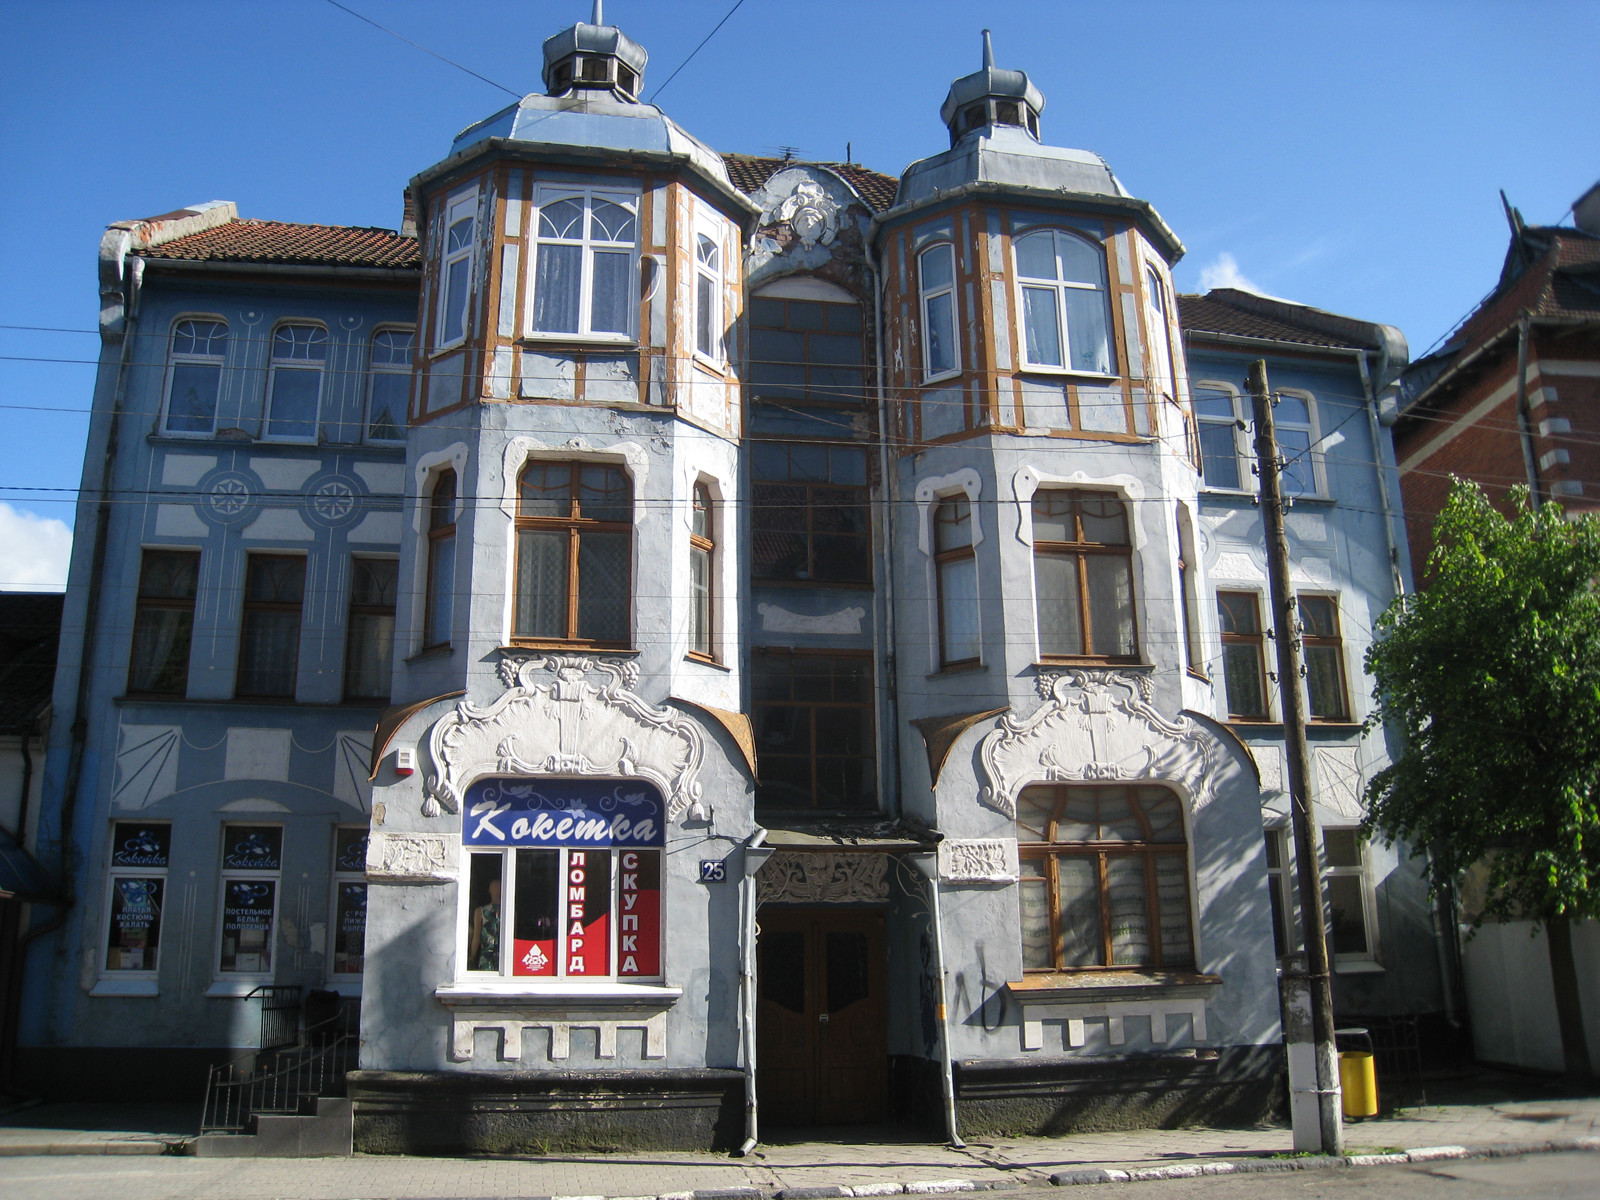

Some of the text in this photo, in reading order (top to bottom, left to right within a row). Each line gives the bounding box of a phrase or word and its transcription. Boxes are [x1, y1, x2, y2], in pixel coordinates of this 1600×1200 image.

[470, 801, 657, 841] Кокетка
[704, 862, 725, 880] 25
[569, 852, 585, 973] ЛОМБАРД
[622, 853, 639, 972] СКУПКА
